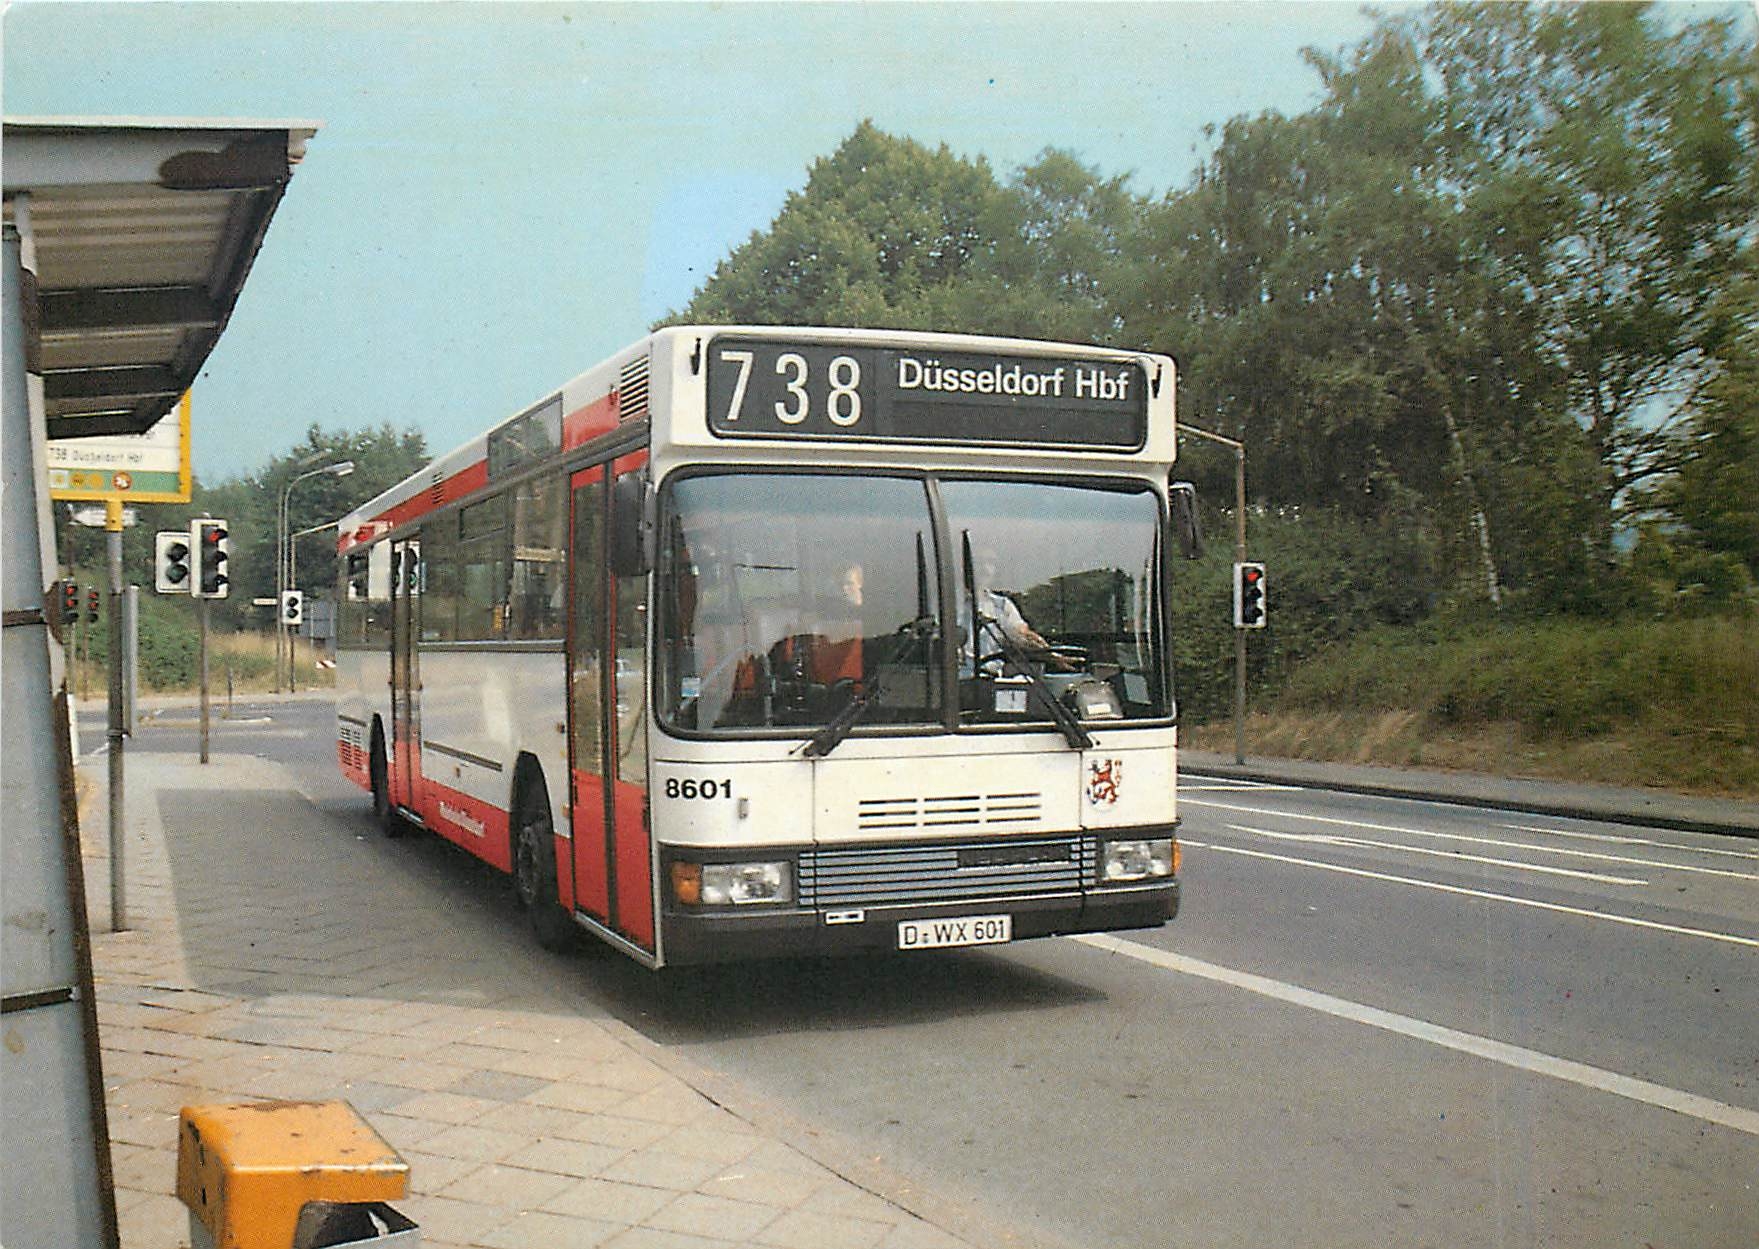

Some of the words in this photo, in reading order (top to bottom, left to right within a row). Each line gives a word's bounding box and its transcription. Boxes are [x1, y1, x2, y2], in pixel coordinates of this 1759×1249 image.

[721, 351, 862, 427] 738
[899, 357, 1064, 396] Düsseldorf
[1073, 368, 1129, 400] Hbf
[666, 778, 731, 799] 8601
[974, 919, 1005, 940] 601
